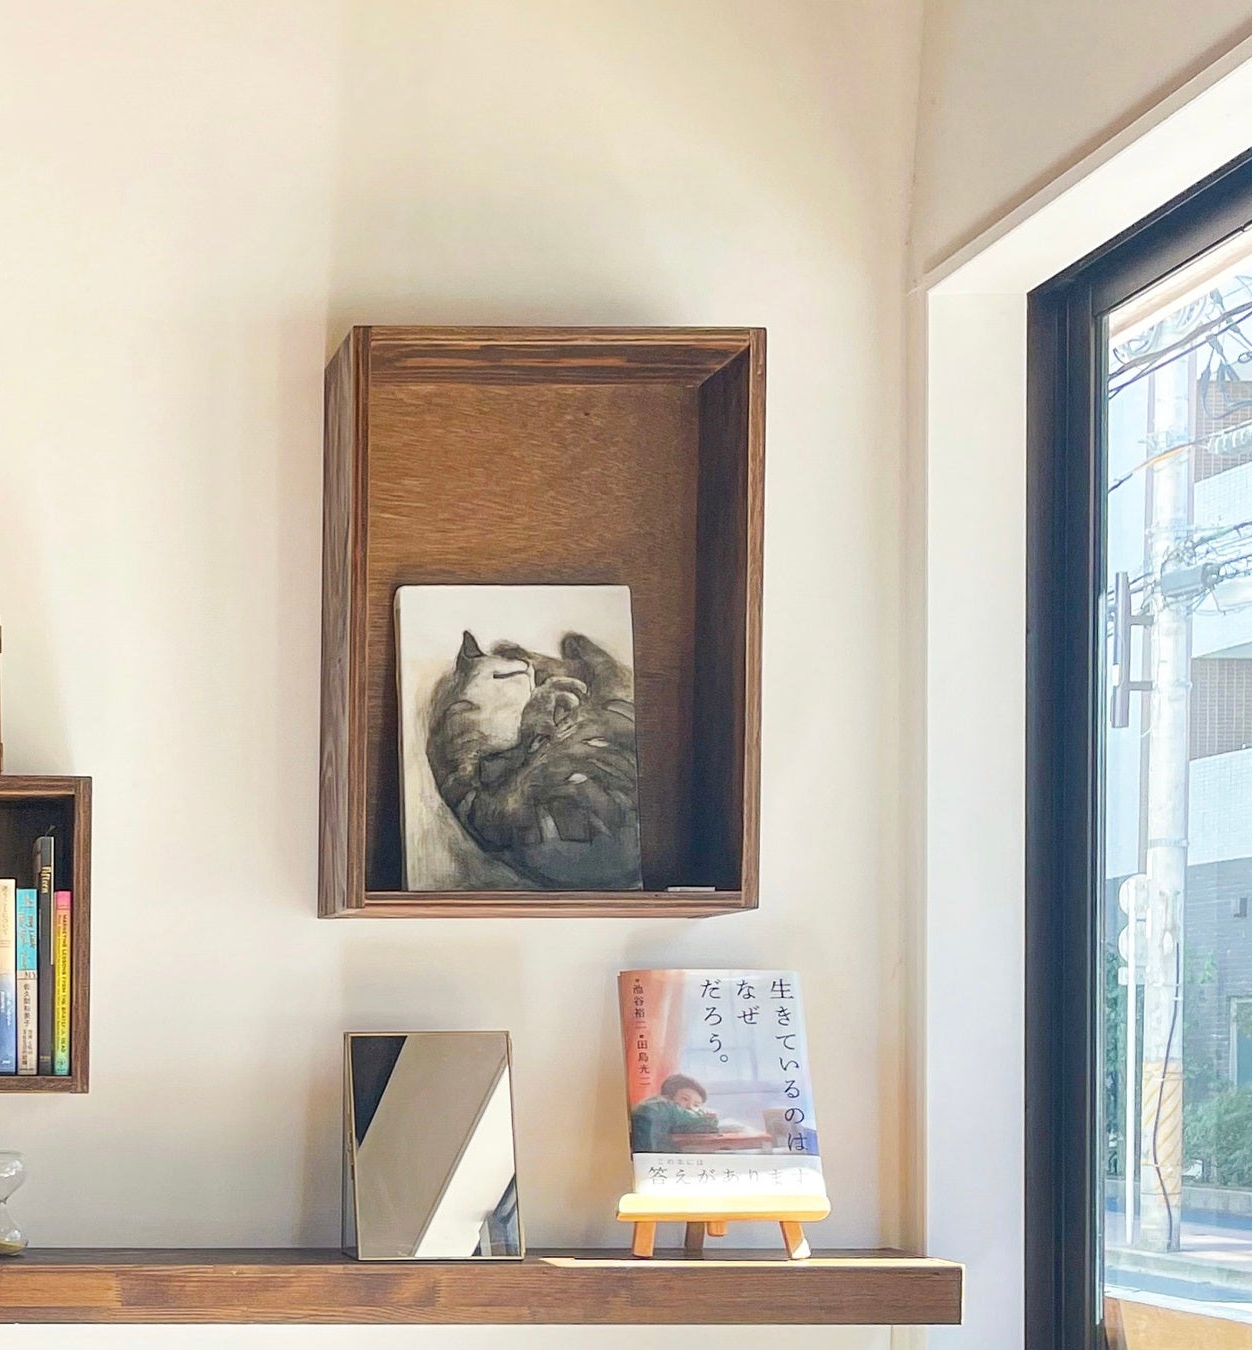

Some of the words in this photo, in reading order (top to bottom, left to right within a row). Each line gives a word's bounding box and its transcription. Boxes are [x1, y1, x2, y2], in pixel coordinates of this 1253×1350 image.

[700, 978, 729, 1063] だろう。
[735, 979, 760, 1026] なぜ
[769, 978, 809, 1152] 生きているのは
